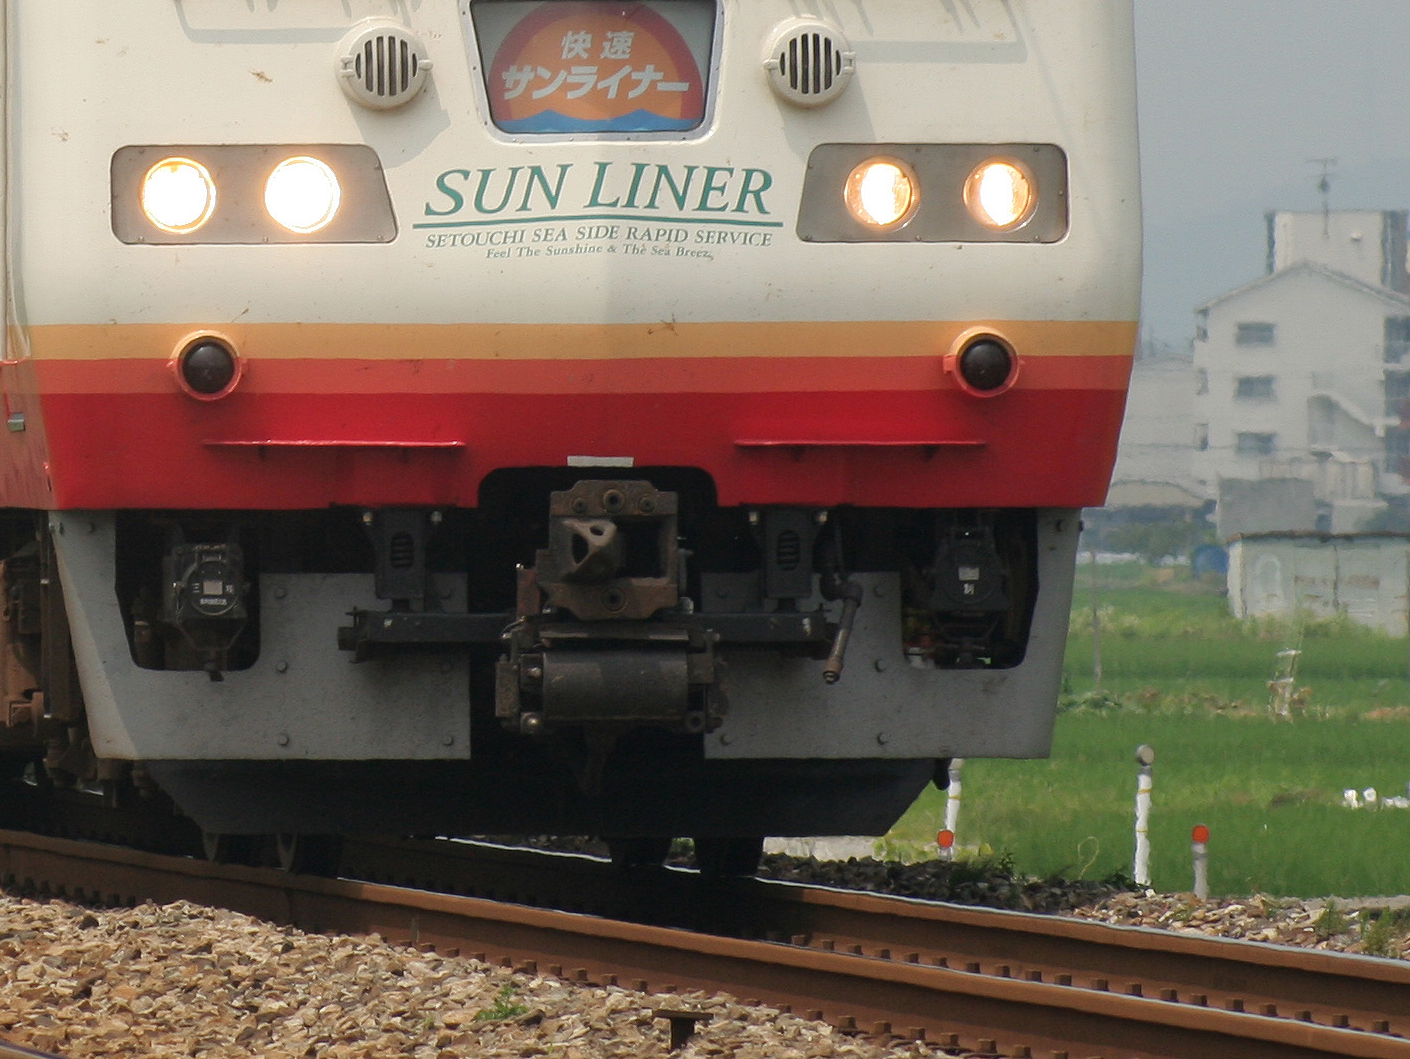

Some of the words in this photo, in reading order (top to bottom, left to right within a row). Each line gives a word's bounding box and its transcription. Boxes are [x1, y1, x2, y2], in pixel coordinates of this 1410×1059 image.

[560, 30, 634, 60] 快速
[501, 64, 689, 100] サンライナー
[424, 163, 574, 216] SUN
[584, 162, 773, 214] LINER
[425, 229, 525, 248] SETOUCHI
[532, 228, 567, 242] SEA
[576, 225, 620, 241] SIDE
[626, 226, 689, 243] RAPID
[695, 230, 773, 247] SERVICE
[486, 248, 511, 259] Feel
[517, 246, 541, 258] The
[546, 244, 603, 256] Sunshine
[607, 245, 617, 253] &
[623, 243, 647, 255] The
[652, 245, 670, 256] Sea
